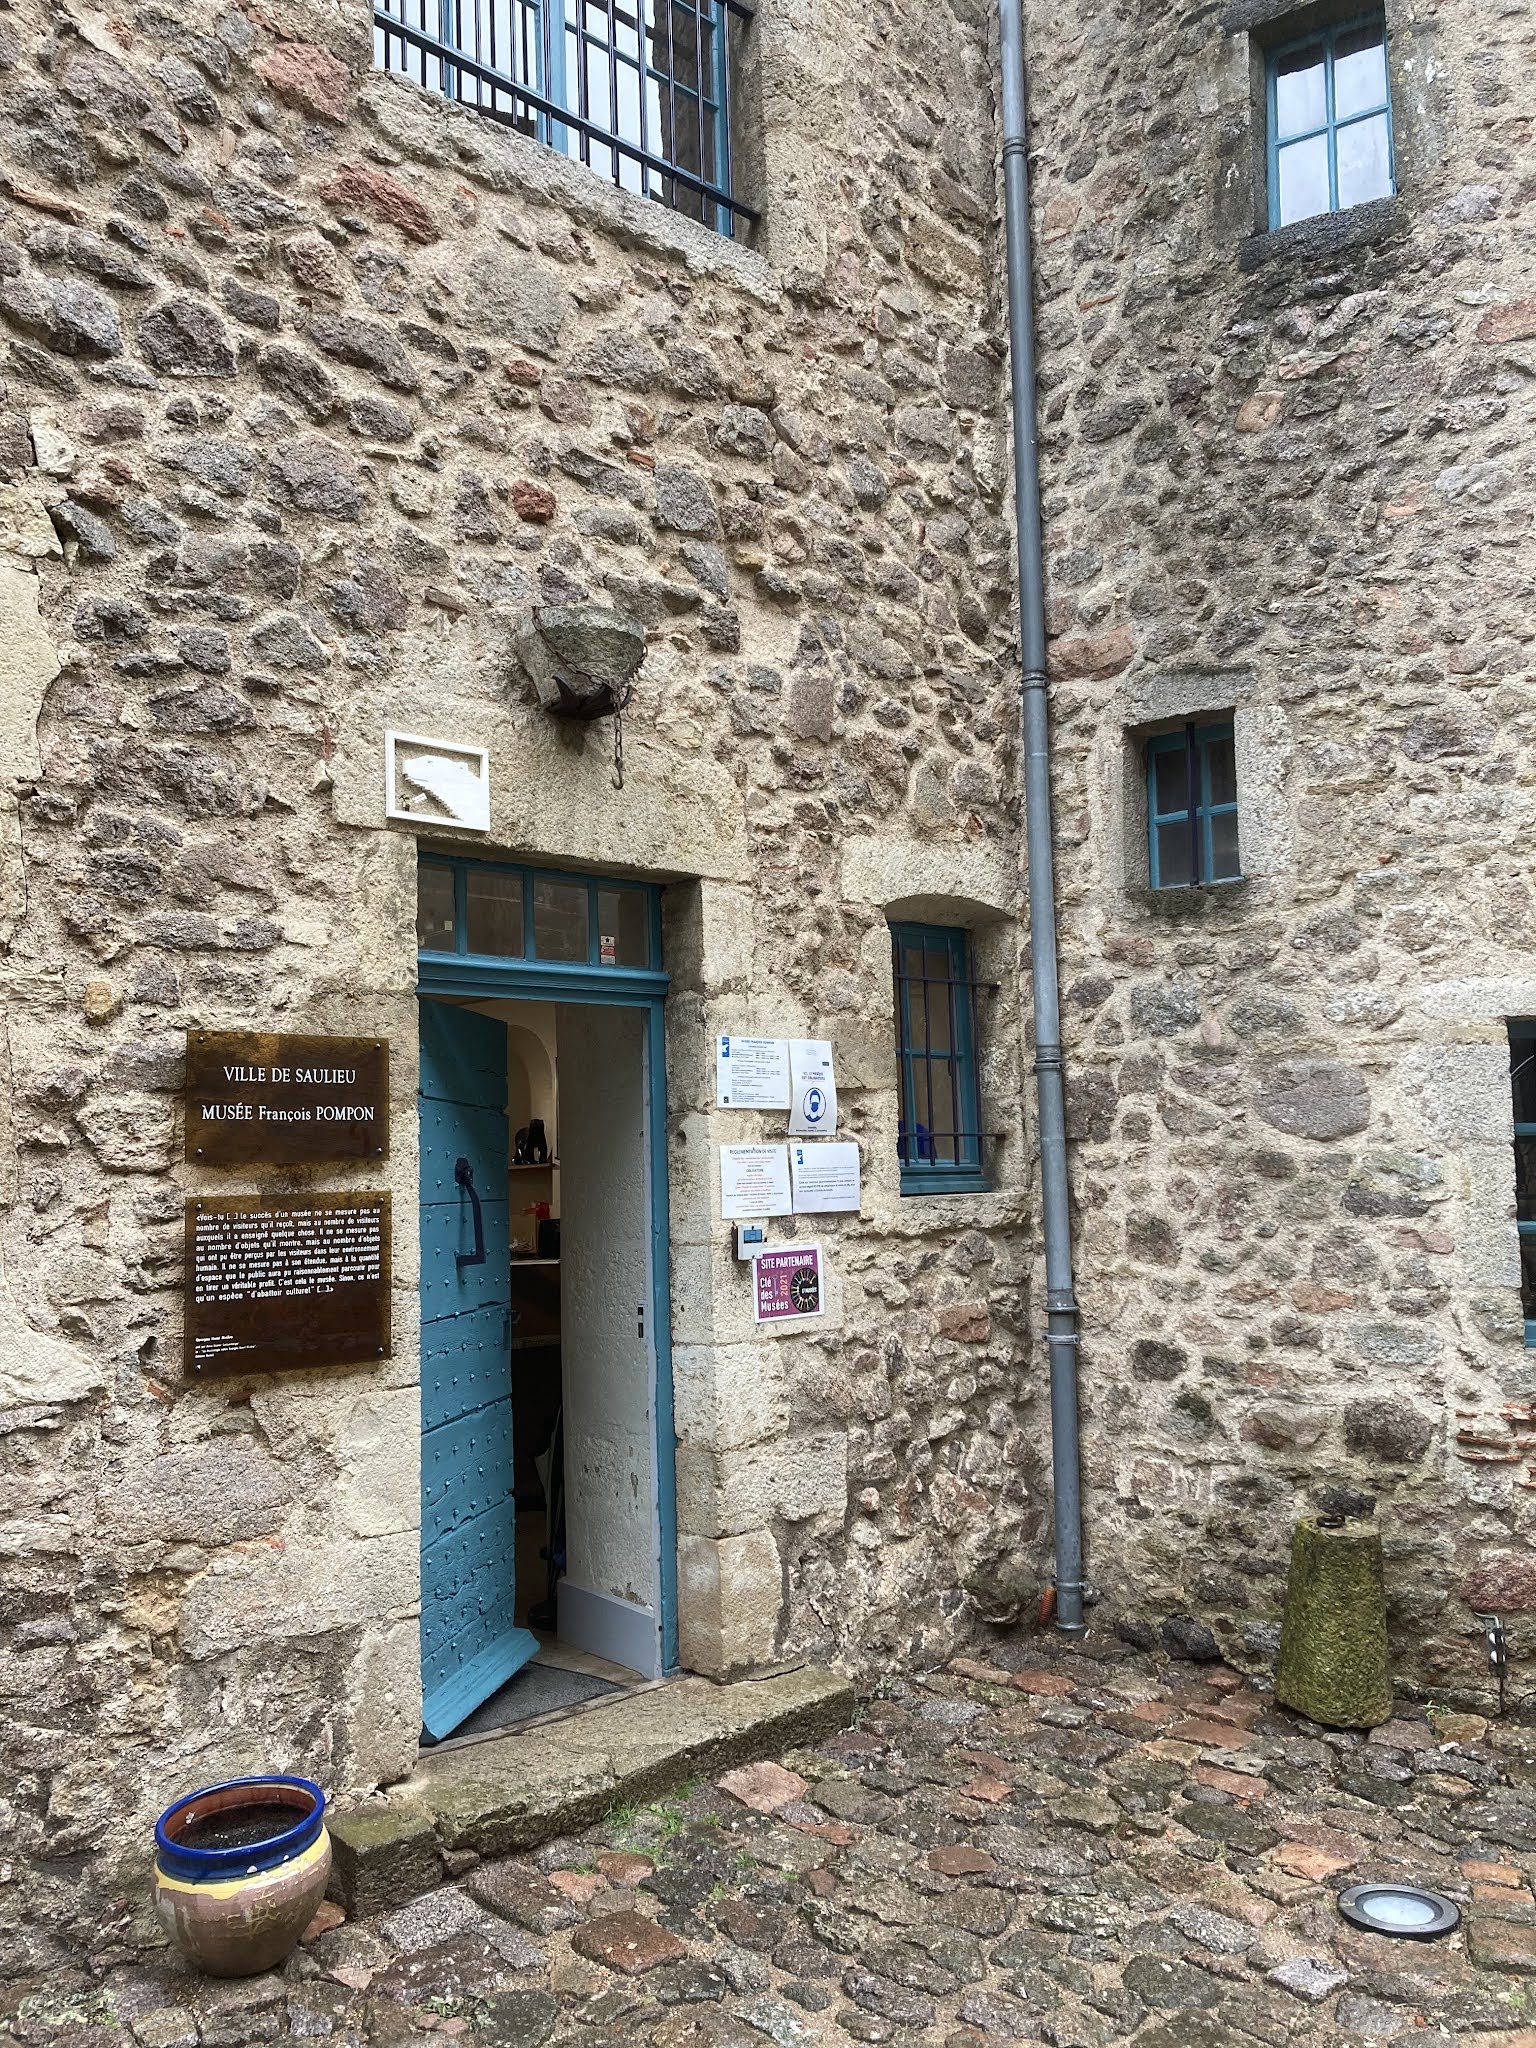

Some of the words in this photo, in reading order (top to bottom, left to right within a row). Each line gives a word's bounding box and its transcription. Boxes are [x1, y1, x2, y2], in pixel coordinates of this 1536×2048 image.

[223, 1066, 266, 1082] VILLE
[272, 1067, 291, 1082] DE
[296, 1068, 356, 1083] SAULIEU
[202, 1103, 252, 1120] MUSÉE
[259, 1106, 311, 1123] François
[316, 1106, 374, 1121] POMPON
[196, 1233, 223, 1242] auxquels
[271, 1231, 294, 1239] quelque
[235, 1242, 259, 1250] d'objets
[196, 1254, 205, 1263] qui
[220, 1254, 227, 1262] pu
[289, 1248, 311, 1256] visiteurs
[761, 1258, 775, 1269] SITE
[776, 1255, 813, 1268] PARTENAIRE
[226, 1273, 236, 1281] que
[248, 1270, 265, 1280] public
[760, 1276, 771, 1288] Clé
[780, 1275, 788, 1296] 2021
[219, 1292, 243, 1301] espèce
[761, 1290, 773, 1300] des
[761, 1300, 788, 1312] Musées
